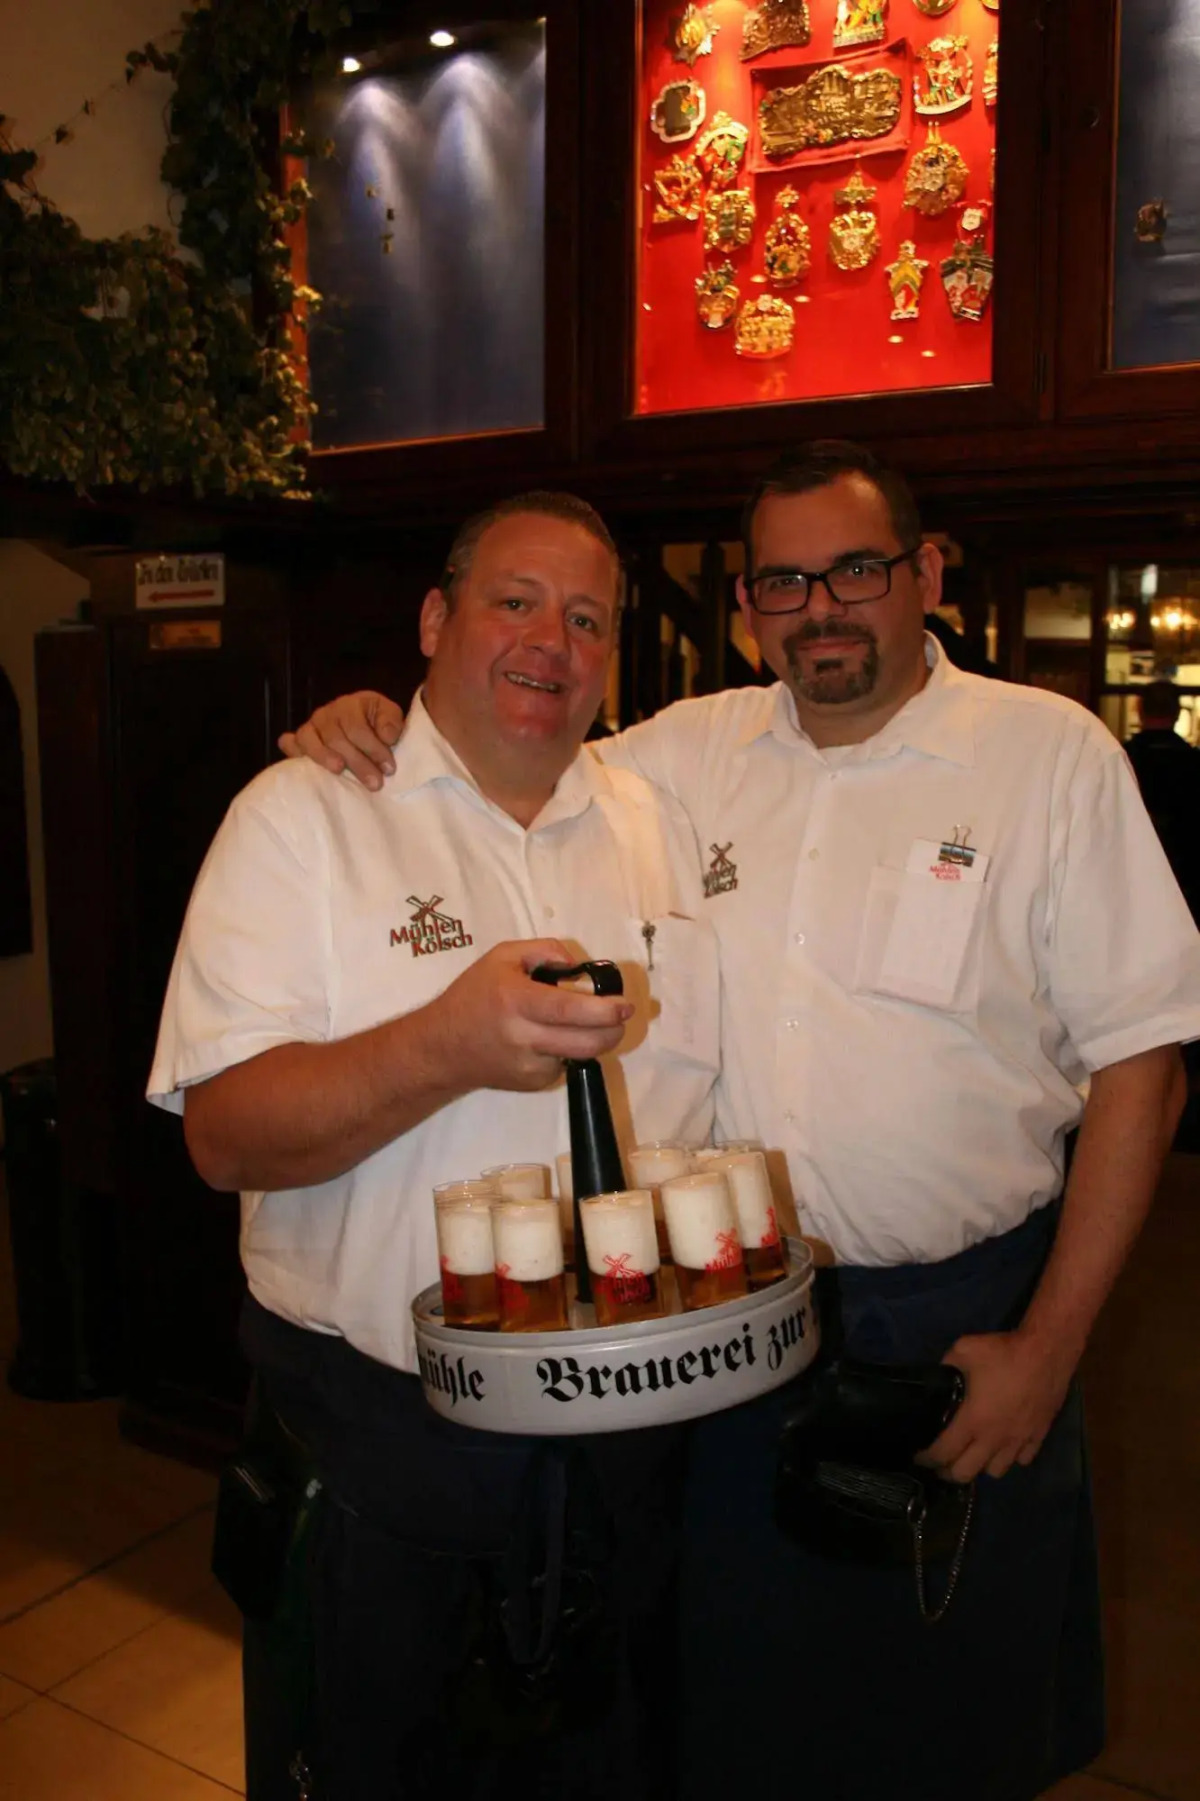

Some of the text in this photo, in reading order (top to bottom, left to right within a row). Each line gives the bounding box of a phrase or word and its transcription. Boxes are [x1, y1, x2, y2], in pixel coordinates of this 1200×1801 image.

[390, 919, 465, 948] Mühlen
[411, 933, 473, 958] Kölsch
[535, 1322, 757, 1403] Brauerei
[766, 1305, 806, 1371] zur
